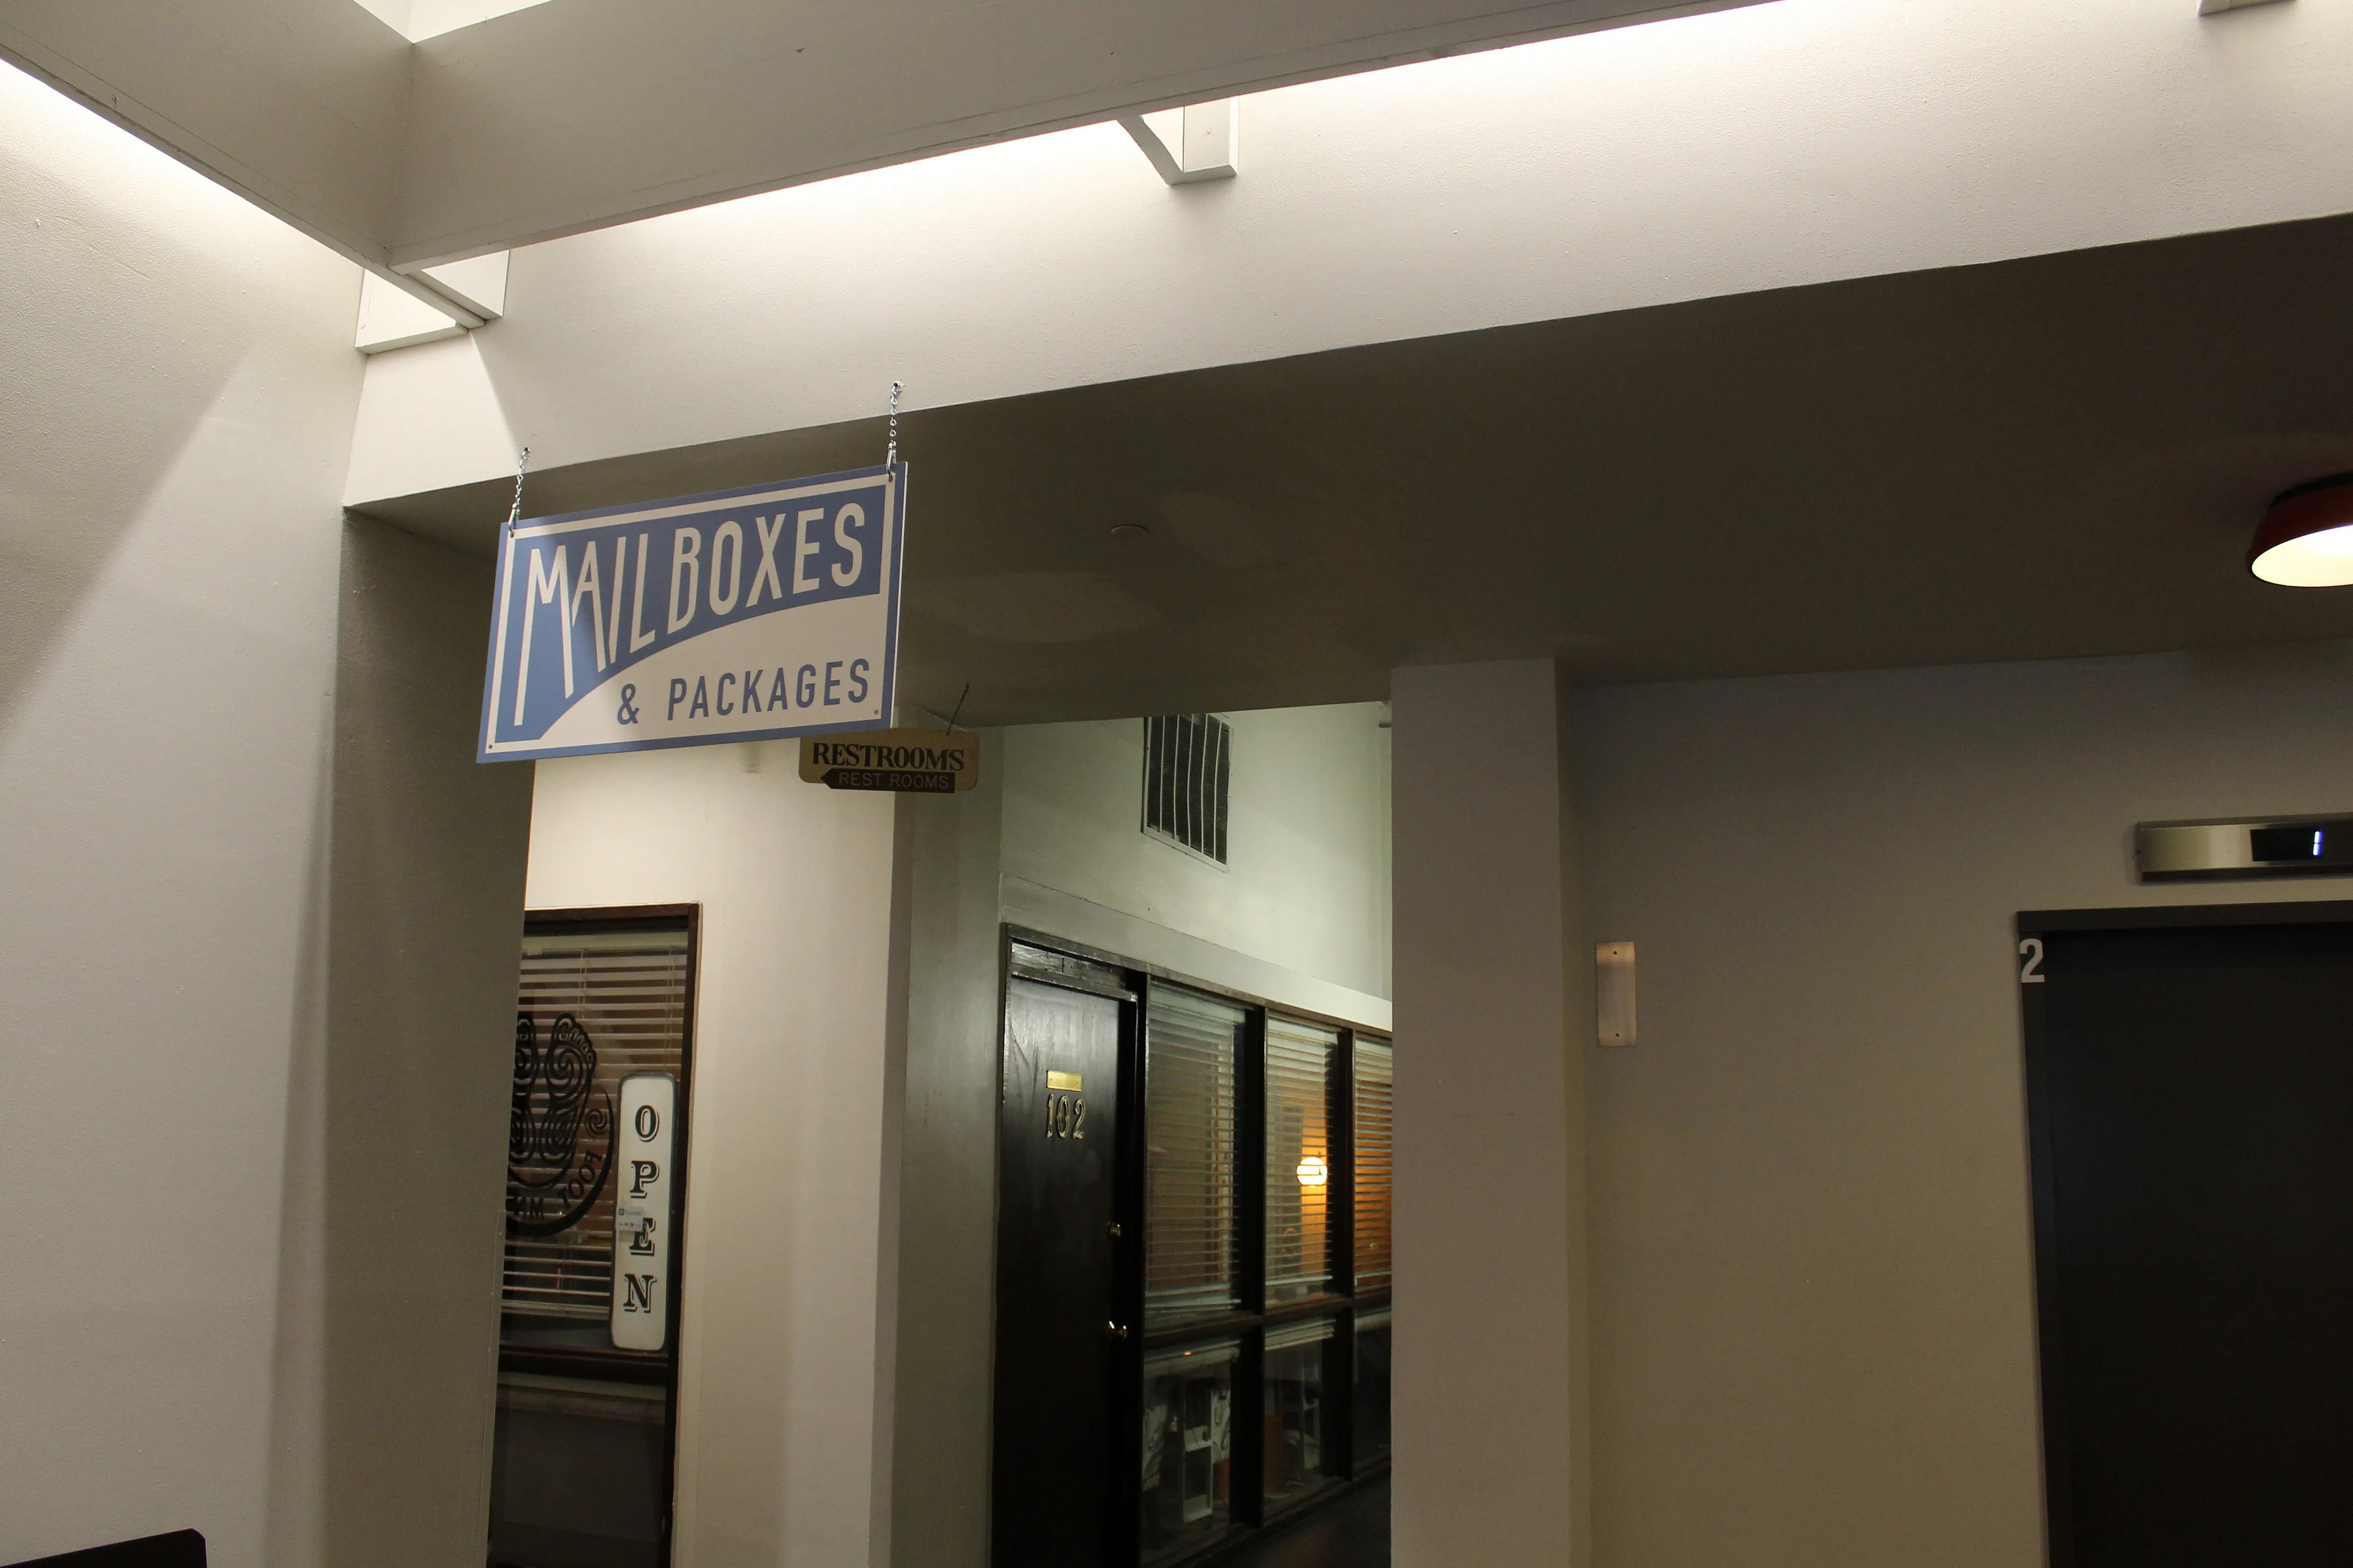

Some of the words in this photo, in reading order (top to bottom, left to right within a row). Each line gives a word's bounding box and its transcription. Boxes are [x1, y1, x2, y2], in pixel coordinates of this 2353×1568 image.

[514, 502, 865, 726] MAILBOXES
[617, 683, 641, 725] &
[668, 658, 869, 720] PACKAGES
[812, 742, 964, 772] RESTROOMS
[839, 771, 885, 787] REST
[890, 774, 948, 790] ROOMS
[2019, 938, 2045, 983] 2
[1045, 1093, 1085, 1140] 102
[623, 1105, 659, 1314] OPEN
